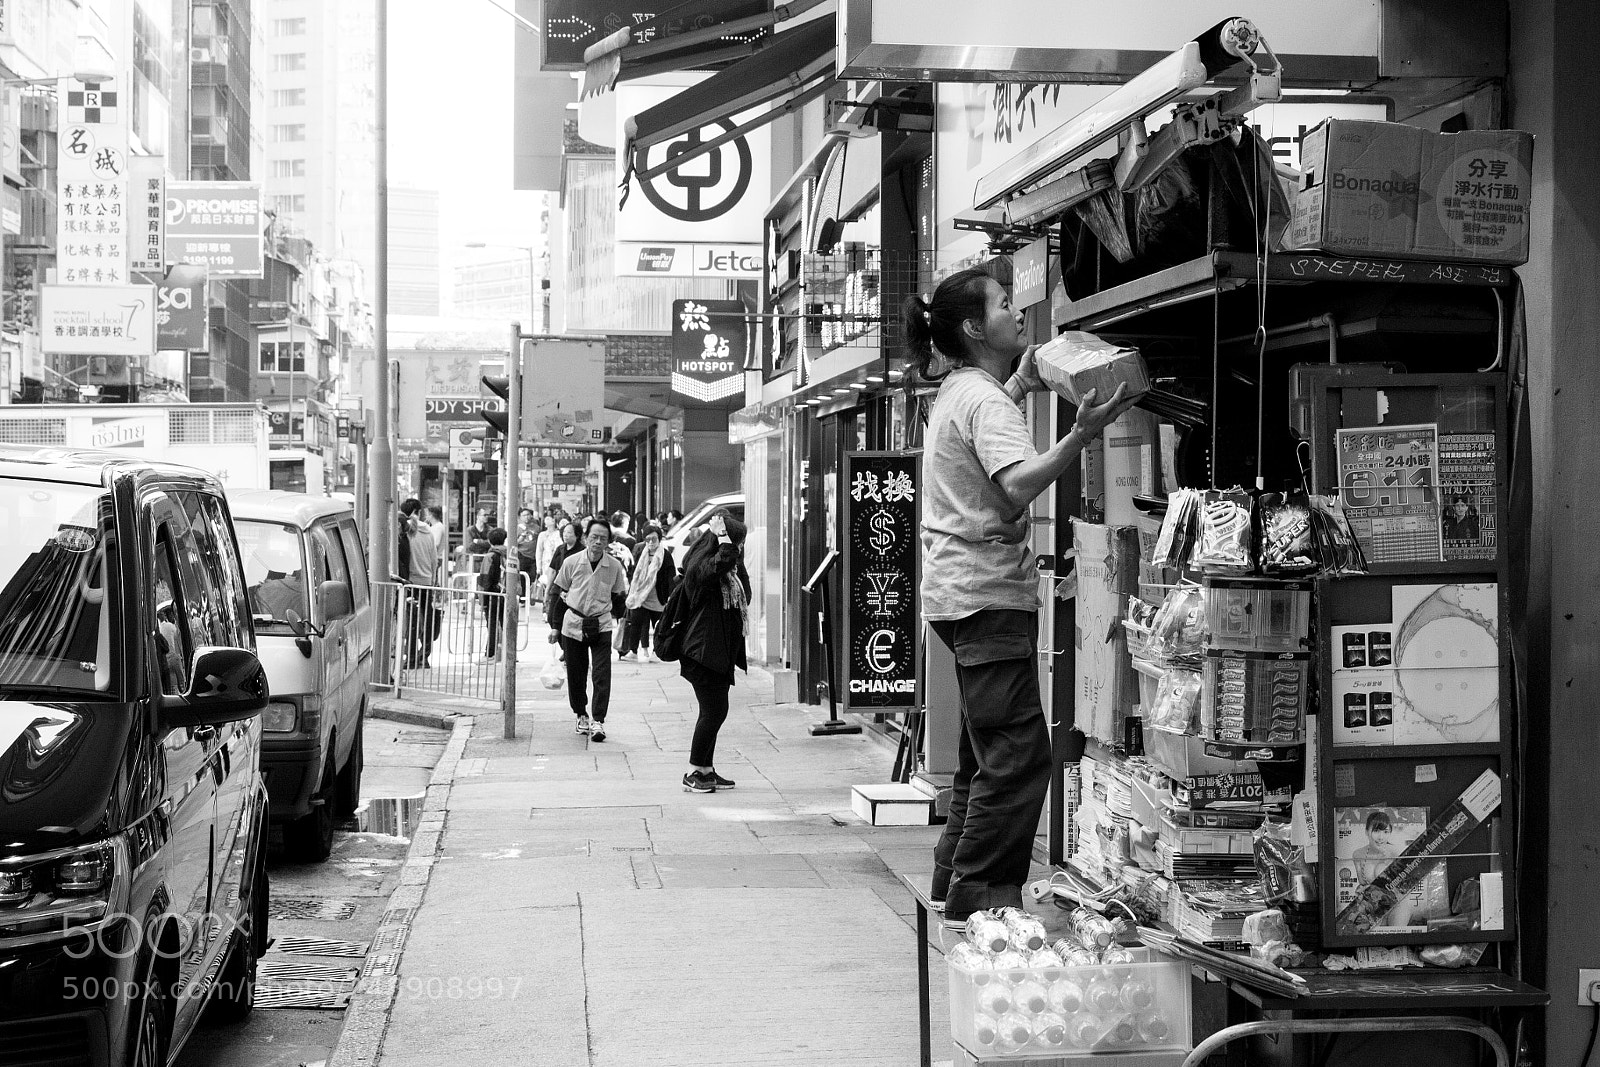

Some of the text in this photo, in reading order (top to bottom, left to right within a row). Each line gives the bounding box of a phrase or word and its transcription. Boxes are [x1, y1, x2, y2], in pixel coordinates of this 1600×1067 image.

[68, 129, 119, 175] 名城
[1468, 158, 1508, 179] 分享
[1332, 173, 1420, 198] Bonaqua
[1454, 180, 1519, 200] 淨水行動
[64, 203, 121, 217] 有限公司
[187, 199, 258, 214] PROMISE
[640, 252, 673, 262] UnionPay
[66, 268, 119, 282] 名牌香水
[53, 311, 124, 324] cocktail school
[54, 325, 123, 338] 香港調酒學校
[681, 361, 735, 372] HOTSPOT
[851, 470, 915, 502] 找換
[869, 510, 896, 555] $
[1268, 521, 1310, 557] SUPER
[867, 573, 899, 615] ¥
[865, 629, 896, 673] €
[849, 679, 916, 693] CHANGE
